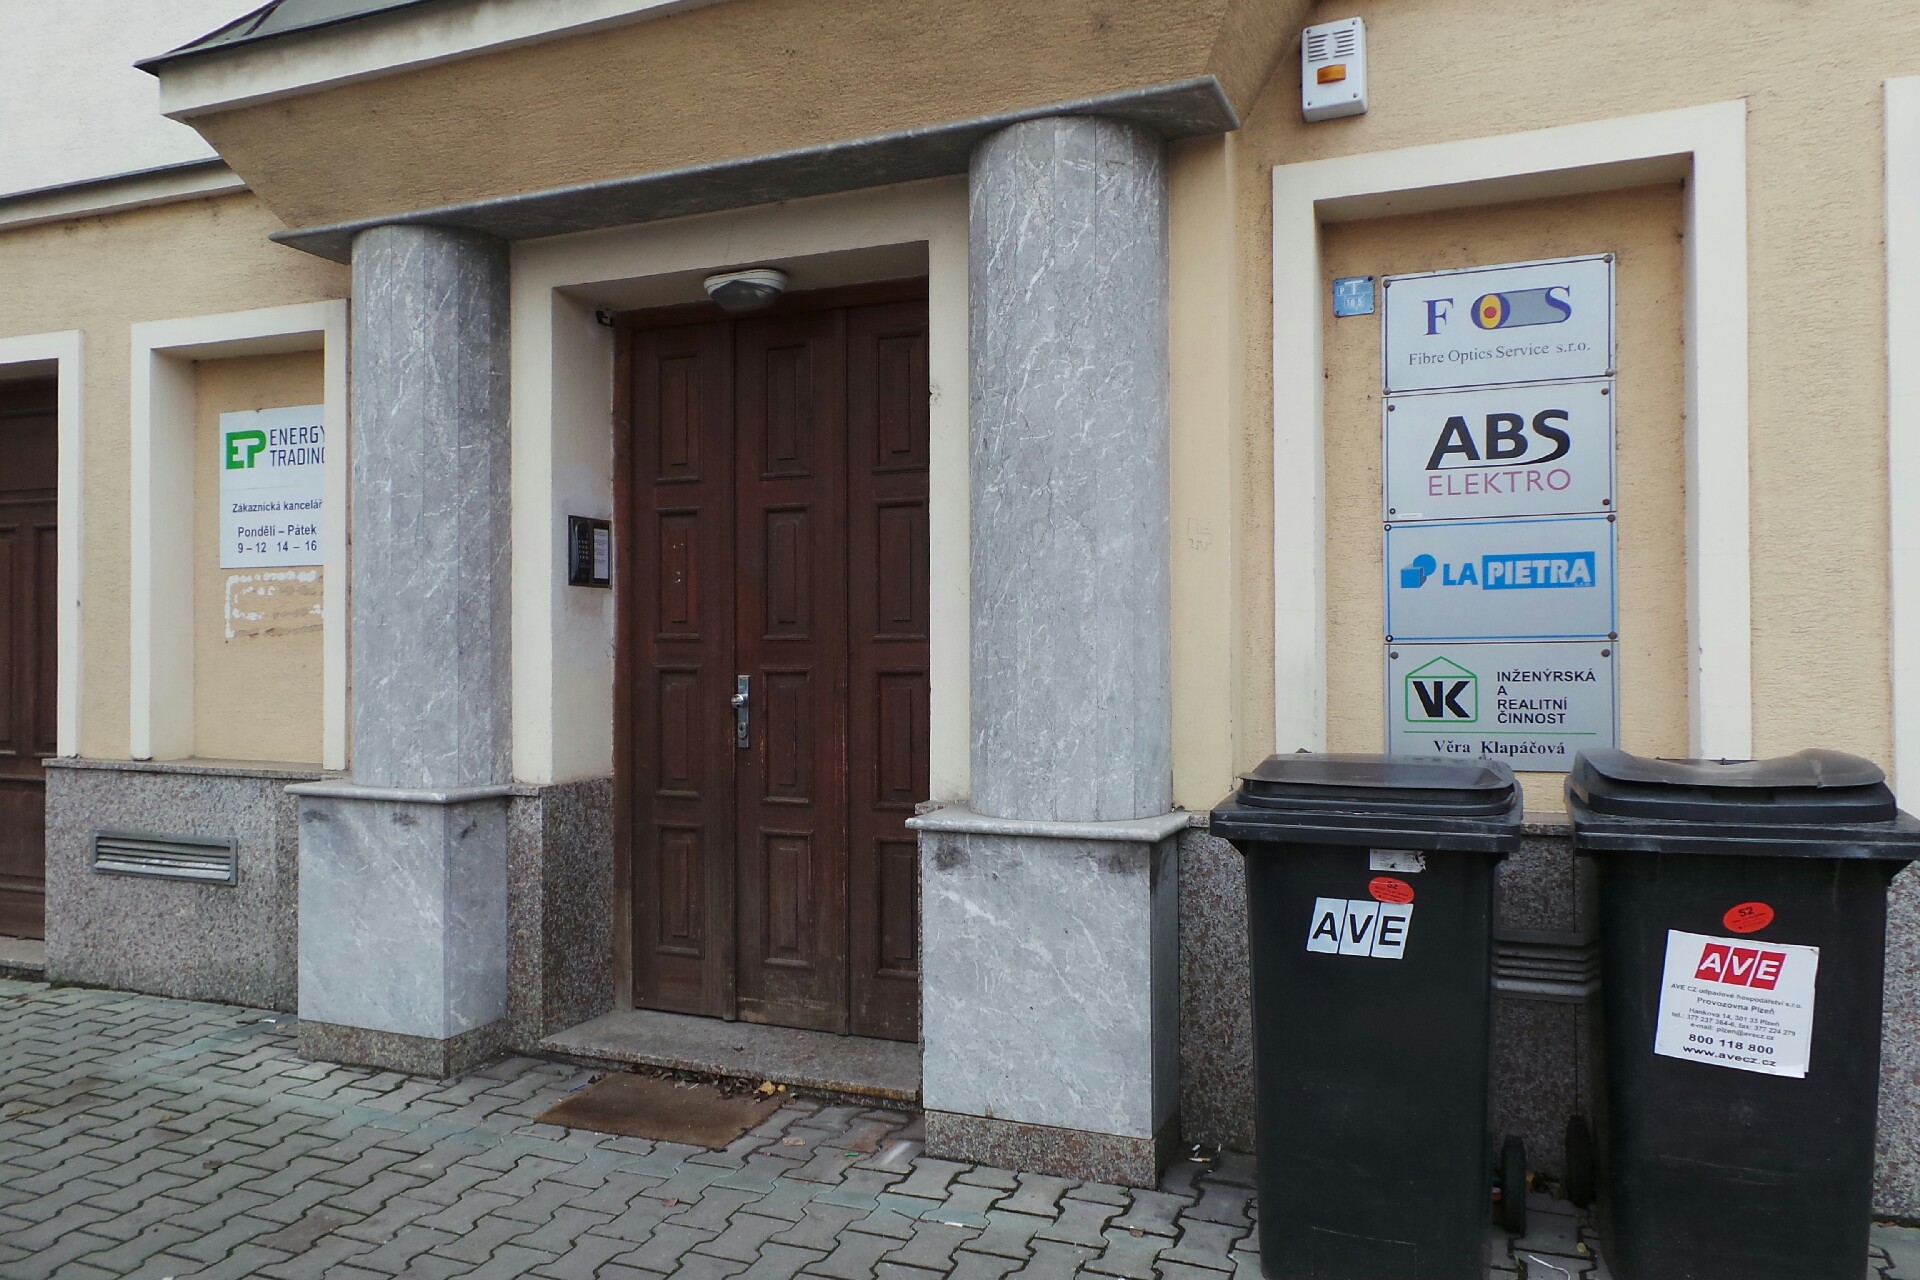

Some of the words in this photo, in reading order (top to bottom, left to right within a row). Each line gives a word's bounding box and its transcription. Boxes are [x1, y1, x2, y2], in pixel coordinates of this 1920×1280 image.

[1409, 352, 1444, 366] Fibre
[1448, 350, 1493, 364] Optics
[1496, 344, 1549, 359] Service
[1556, 341, 1591, 353] s.r.o.
[1425, 409, 1571, 470] ABS
[226, 430, 266, 469] EP
[1428, 468, 1571, 496] ELEKTRO
[232, 501, 280, 513] Zákaznická
[284, 499, 323, 510] kancelář
[288, 524, 317, 536] Pátek
[238, 542, 244, 554] 9
[256, 542, 266, 553] 12
[277, 541, 288, 552] 14
[305, 540, 317, 551] 16
[1443, 562, 1478, 586] LA
[1487, 559, 1592, 585] PIETRA
[1497, 668, 1596, 682] INŽENÝRSKÁ
[1412, 681, 1471, 718] VK
[1497, 685, 1508, 695] A
[1497, 697, 1567, 710] REALITNÍ
[1497, 710, 1566, 724] ČINNOST
[1433, 740, 1471, 753] Věra
[1481, 740, 1565, 757] Klapáčová
[1738, 906, 1755, 918] 52
[1312, 912, 1406, 946] AVE
[1699, 952, 1780, 981] AVE
[1697, 996, 1748, 1010] Provozovna
[1751, 1004, 1775, 1014] Plzeň
[1688, 1034, 1714, 1045] 800
[1720, 1039, 1744, 1050] 118
[1748, 1044, 1774, 1055] 800
[1682, 1046, 1776, 1067] www.avecz.cz
